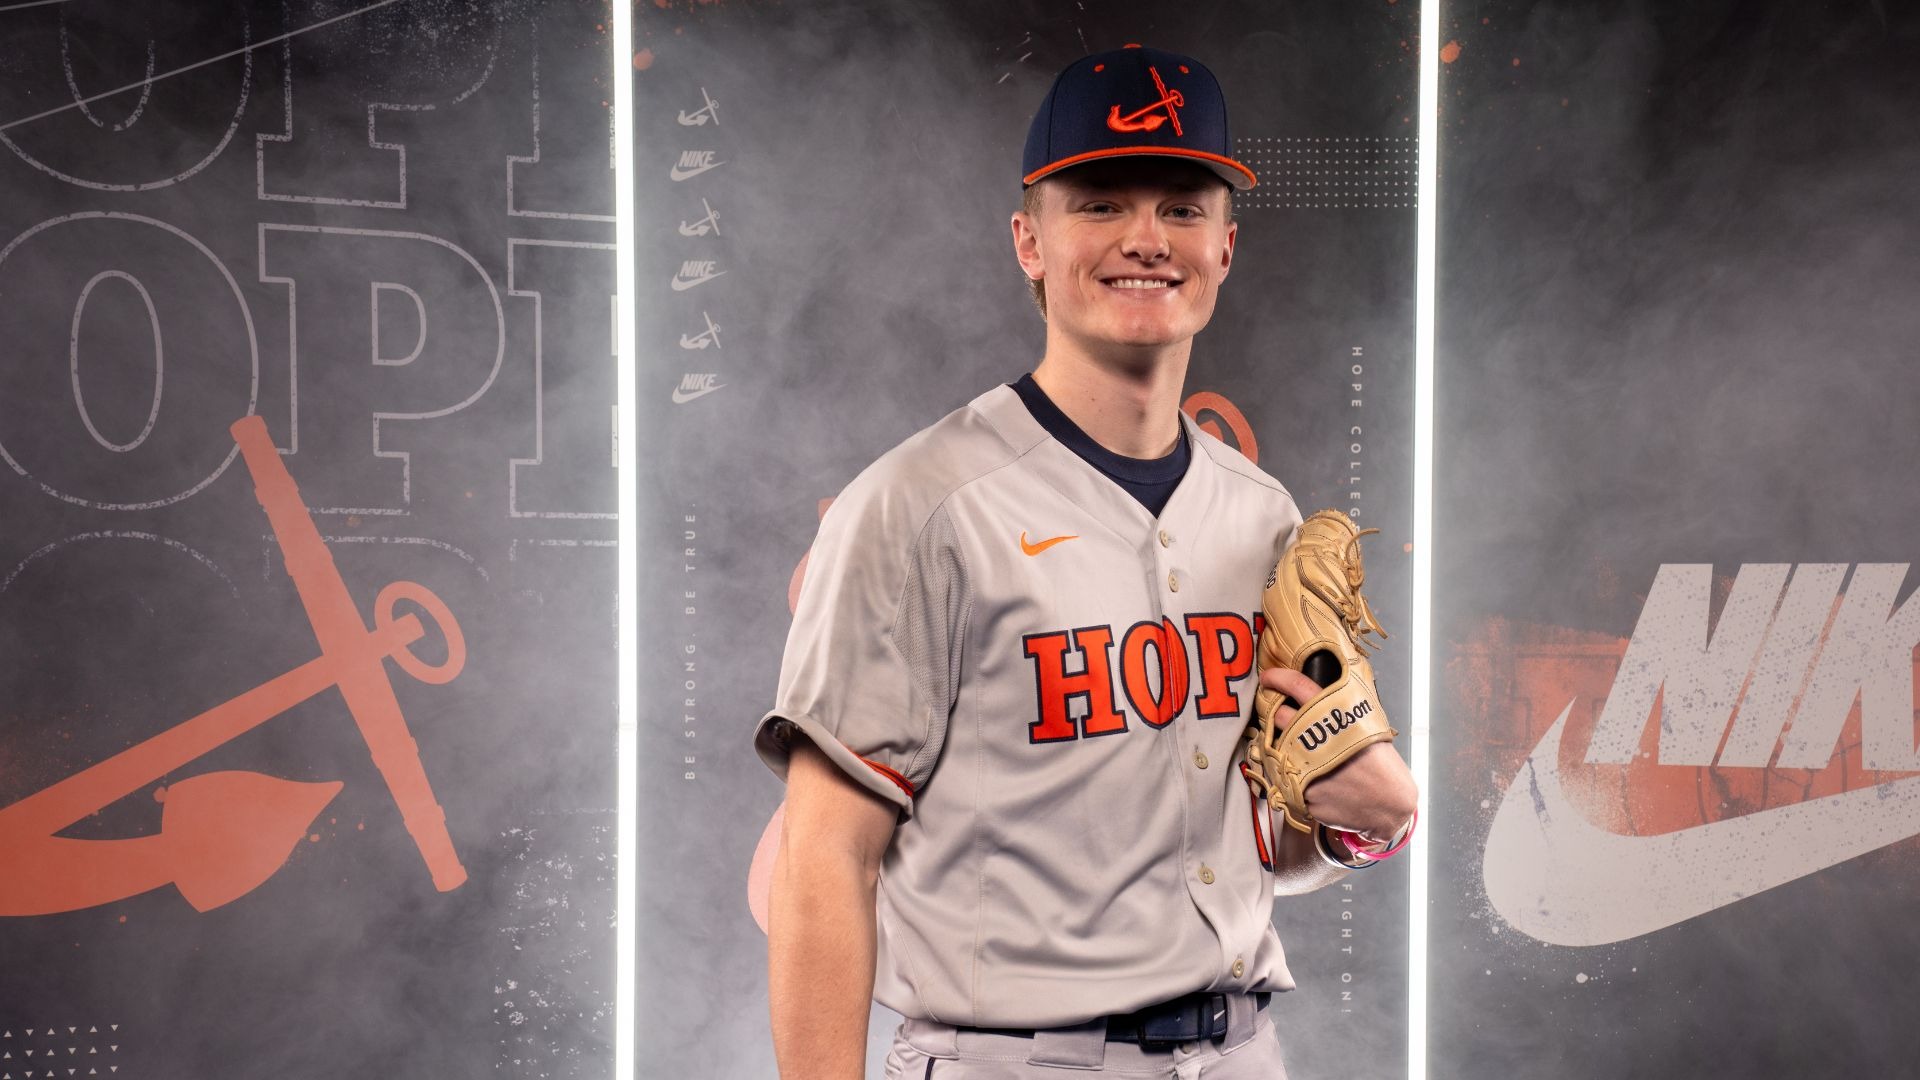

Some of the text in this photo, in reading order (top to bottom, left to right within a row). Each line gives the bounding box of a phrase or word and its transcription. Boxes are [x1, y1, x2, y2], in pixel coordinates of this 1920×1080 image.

[678, 150, 716, 168] NIKE
[680, 260, 717, 277] NIKE
[681, 373, 717, 391] NIKE
[1352, 347, 1363, 407] HOPE
[685, 502, 696, 780] BE STRONG. BE TRUE.
[1022, 611, 1266, 744] HOP
[1298, 699, 1373, 751] Wilson
[1341, 883, 1352, 1012] FIGHT ON!
